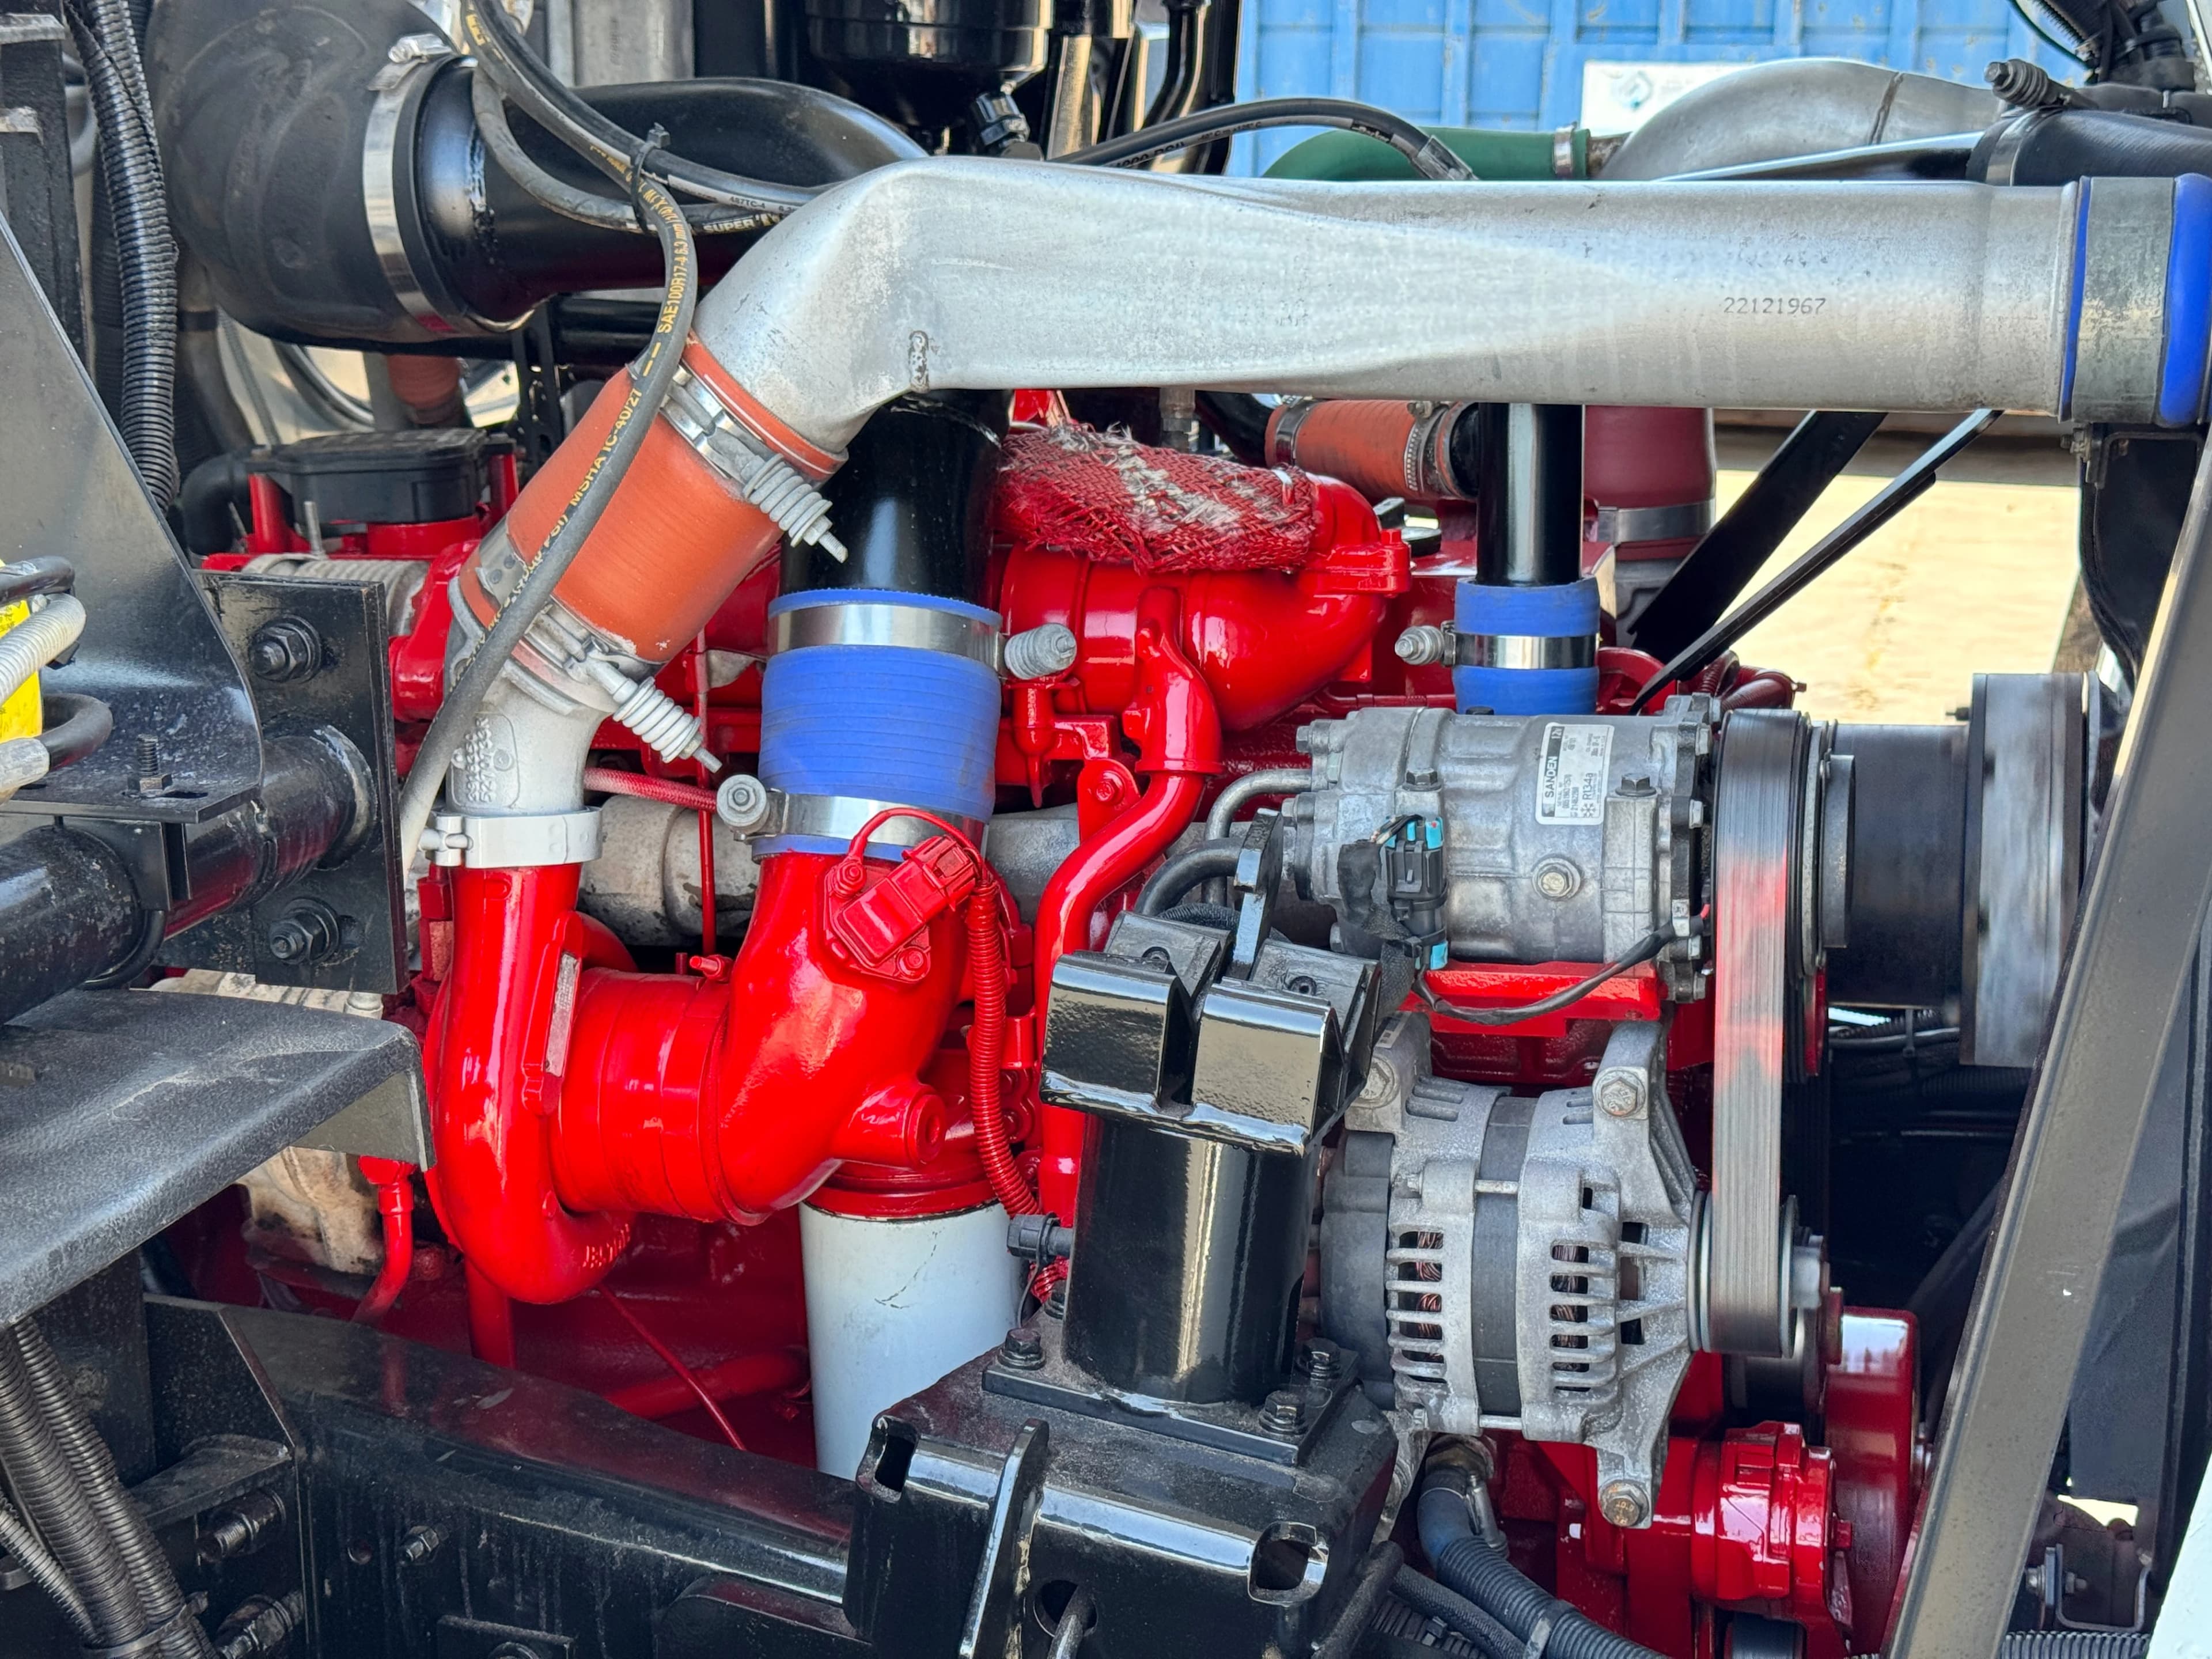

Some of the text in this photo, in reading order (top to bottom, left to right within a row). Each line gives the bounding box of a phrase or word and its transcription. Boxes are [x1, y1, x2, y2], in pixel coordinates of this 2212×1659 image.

[703, 218, 756, 233] SUPER
[657, 256, 689, 334] SAE100R17-4
[1723, 297, 1826, 315] 22121967
[569, 456, 607, 507] MSHA
[602, 388, 643, 452] IC-40/27
[1544, 756, 1558, 798] SANDEN
[1582, 772, 1594, 800] R134a
